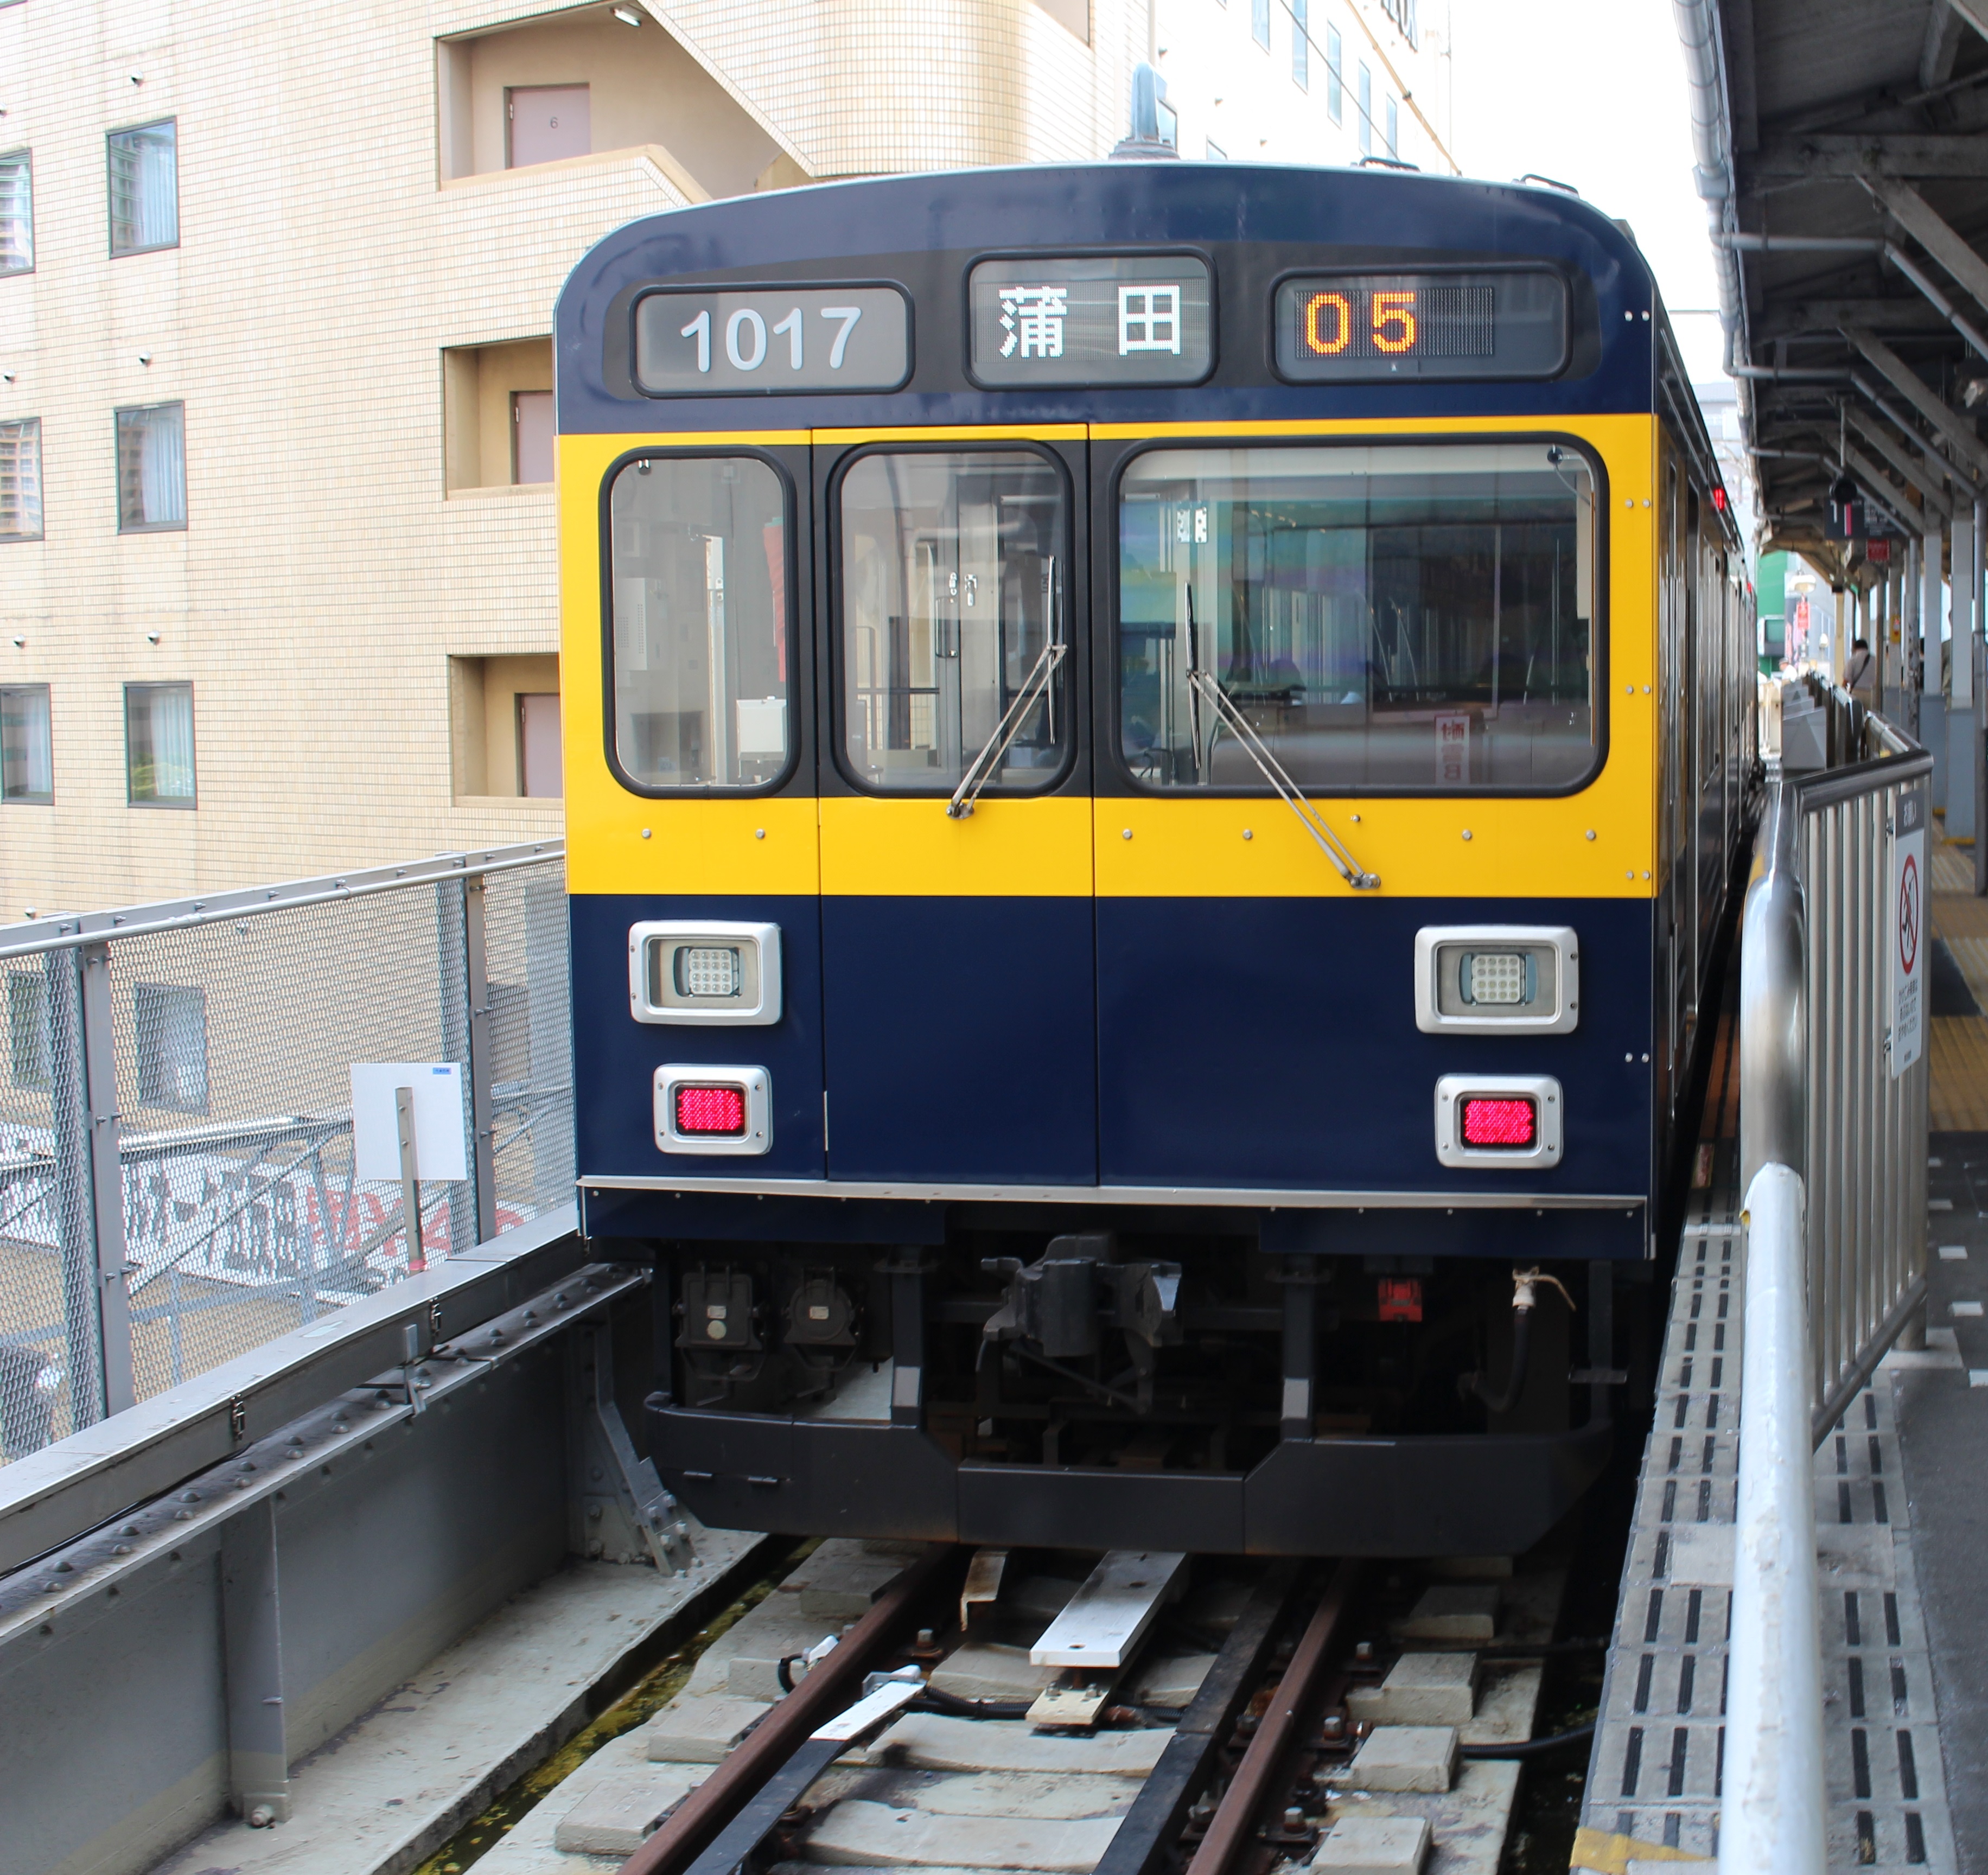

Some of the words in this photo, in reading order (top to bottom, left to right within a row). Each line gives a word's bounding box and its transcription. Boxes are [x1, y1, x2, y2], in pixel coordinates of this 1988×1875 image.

[550, 116, 558, 129] 6
[681, 307, 862, 373] 1017
[998, 285, 1180, 359] 蒲田
[1307, 292, 1417, 354] 05
